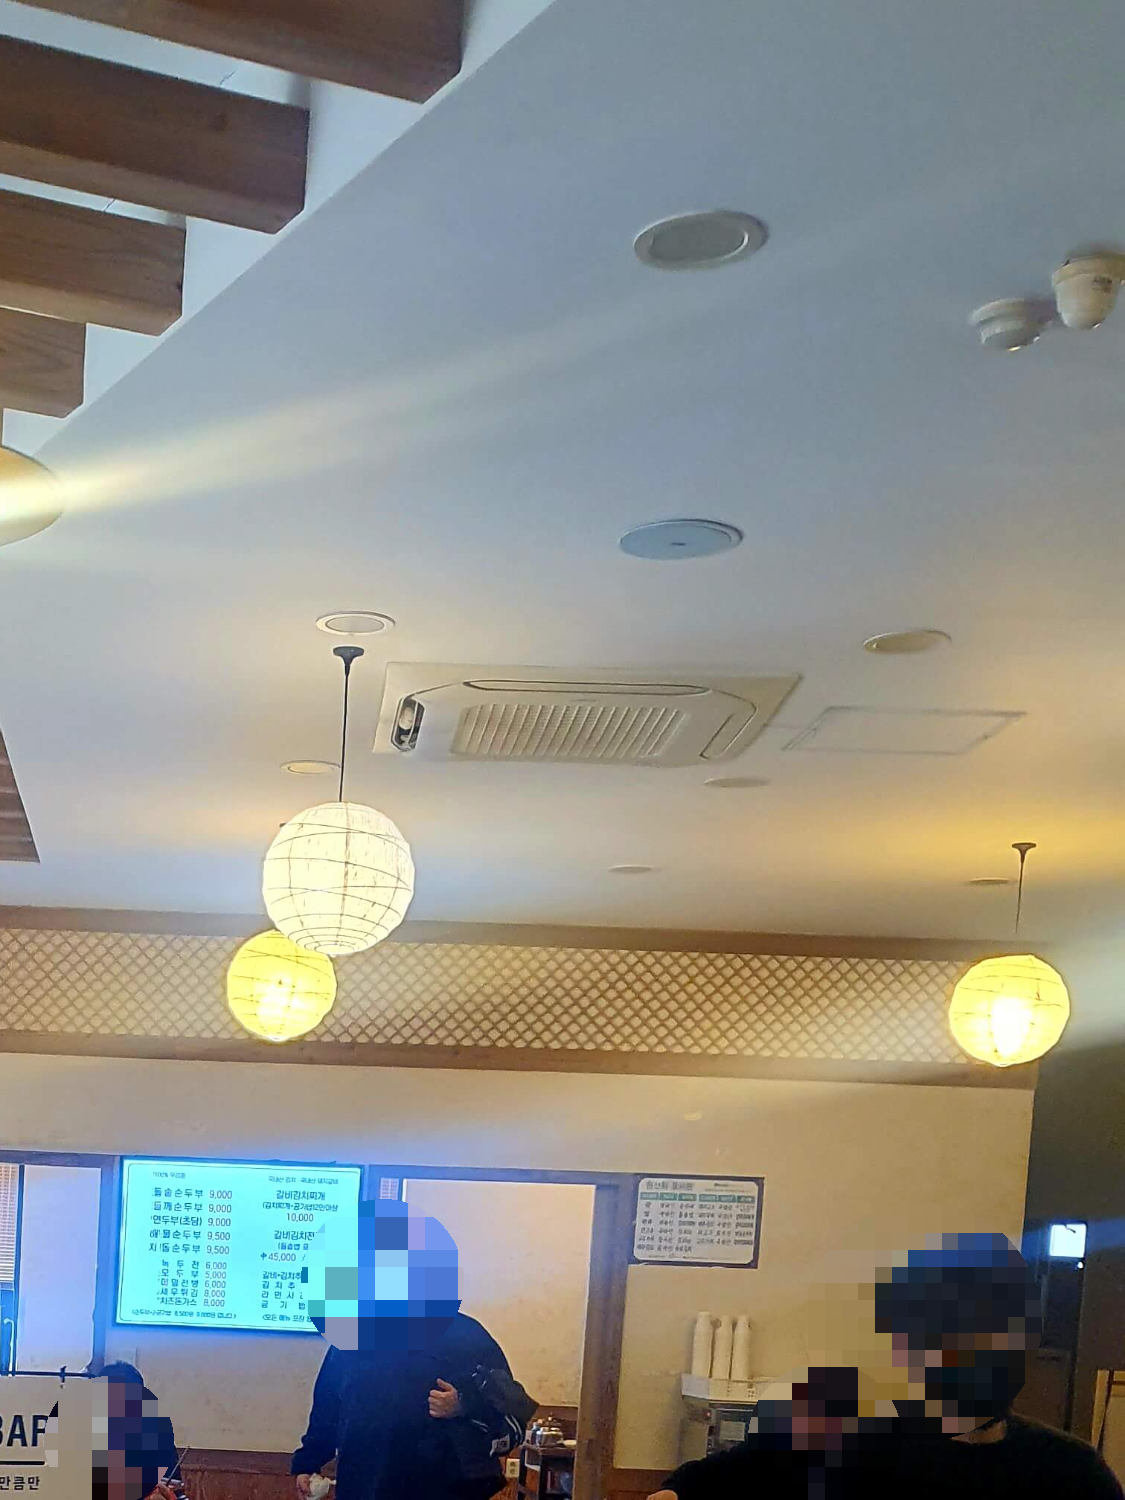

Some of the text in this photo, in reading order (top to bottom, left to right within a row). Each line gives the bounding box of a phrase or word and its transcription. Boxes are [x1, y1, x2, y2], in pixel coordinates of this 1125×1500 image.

[209, 1190, 233, 1199] 9,000
[276, 1190, 326, 1201] 갈비김치찌개
[208, 1204, 232, 1214] 9,000
[208, 1217, 231, 1227] 9,000
[287, 1213, 314, 1222] 10,000
[207, 1231, 231, 1241] 9,500
[274, 1230, 316, 1241] 갈비김치전
[206, 1245, 230, 1255] 9,500
[268, 1252, 297, 1262] 45,000
[205, 1261, 227, 1270] 6,000
[205, 1271, 226, 1279] 5,000
[262, 1270, 302, 1281] 갈비+김치추
[204, 1280, 226, 1289] 6,000
[204, 1289, 226, 1298] 8,000
[203, 1298, 225, 1307] 8,000
